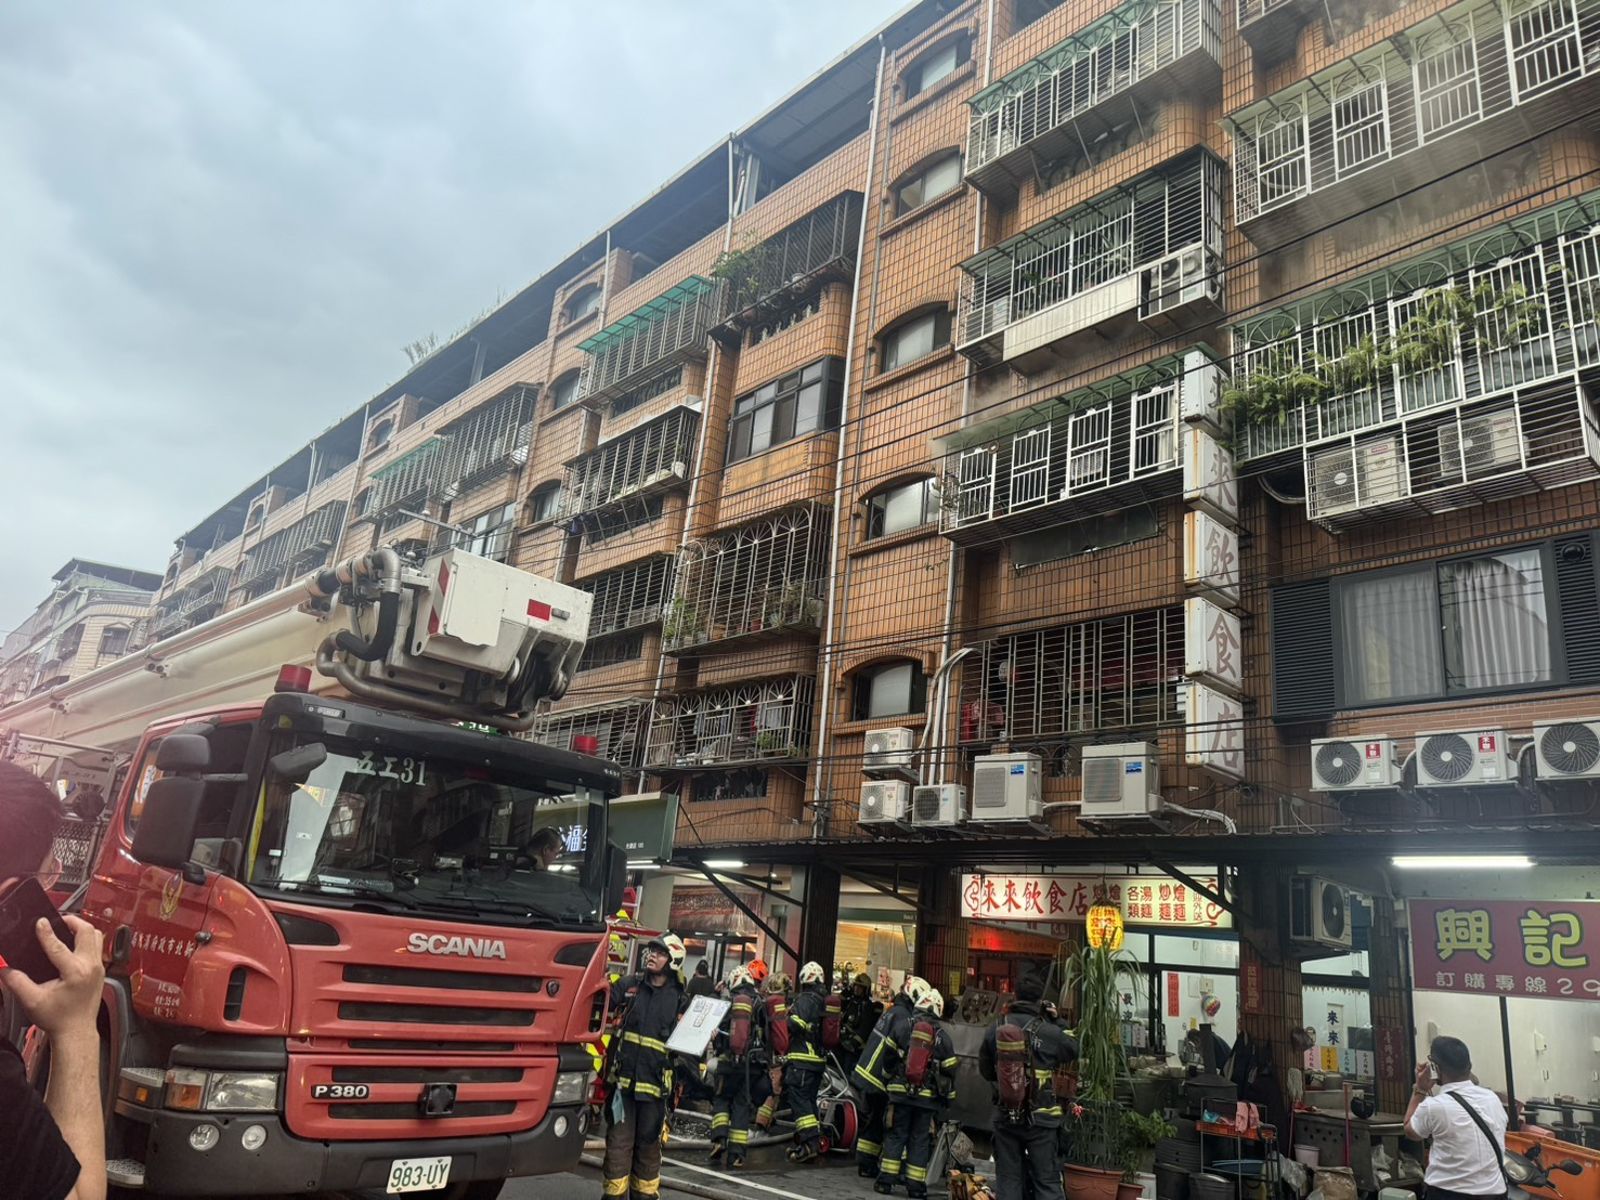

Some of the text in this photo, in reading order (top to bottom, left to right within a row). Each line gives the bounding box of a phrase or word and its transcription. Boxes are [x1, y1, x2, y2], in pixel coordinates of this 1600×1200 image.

[981, 880, 1089, 914] 來來飲食店
[406, 932, 507, 959] SCANIA
[1435, 908, 1588, 968] 興記
[390, 1163, 448, 1188] 983-UY
